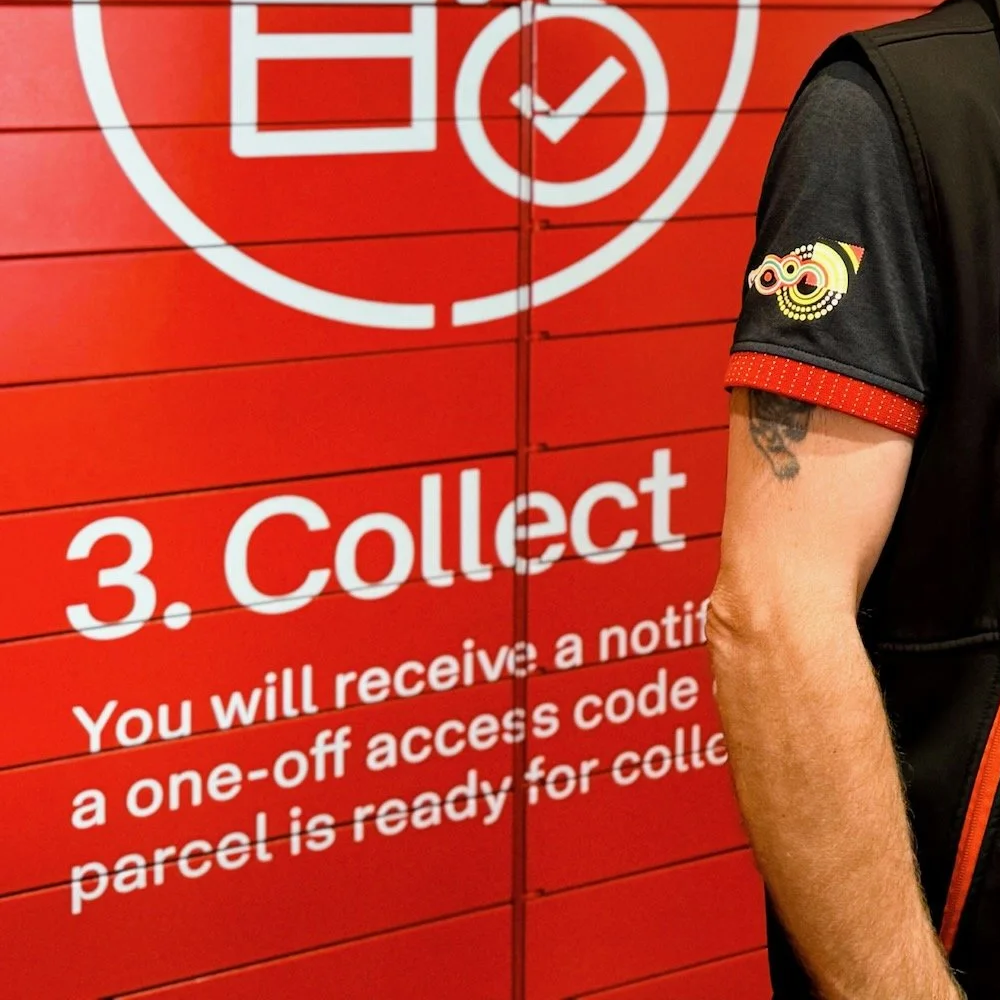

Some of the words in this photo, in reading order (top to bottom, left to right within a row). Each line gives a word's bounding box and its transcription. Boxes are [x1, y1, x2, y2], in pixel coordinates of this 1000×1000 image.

[66, 515, 192, 640] 3.
[223, 448, 687, 615] Collect
[71, 699, 192, 753] You
[210, 664, 319, 730] will
[335, 638, 537, 709] receive
[554, 633, 583, 669] a
[71, 788, 106, 830] a
[126, 725, 352, 818] one-off
[366, 702, 560, 771] access
[573, 667, 699, 730] code
[70, 812, 273, 915] parcel
[289, 806, 336, 856] is
[353, 769, 512, 842] ready
[524, 755, 599, 805] for
